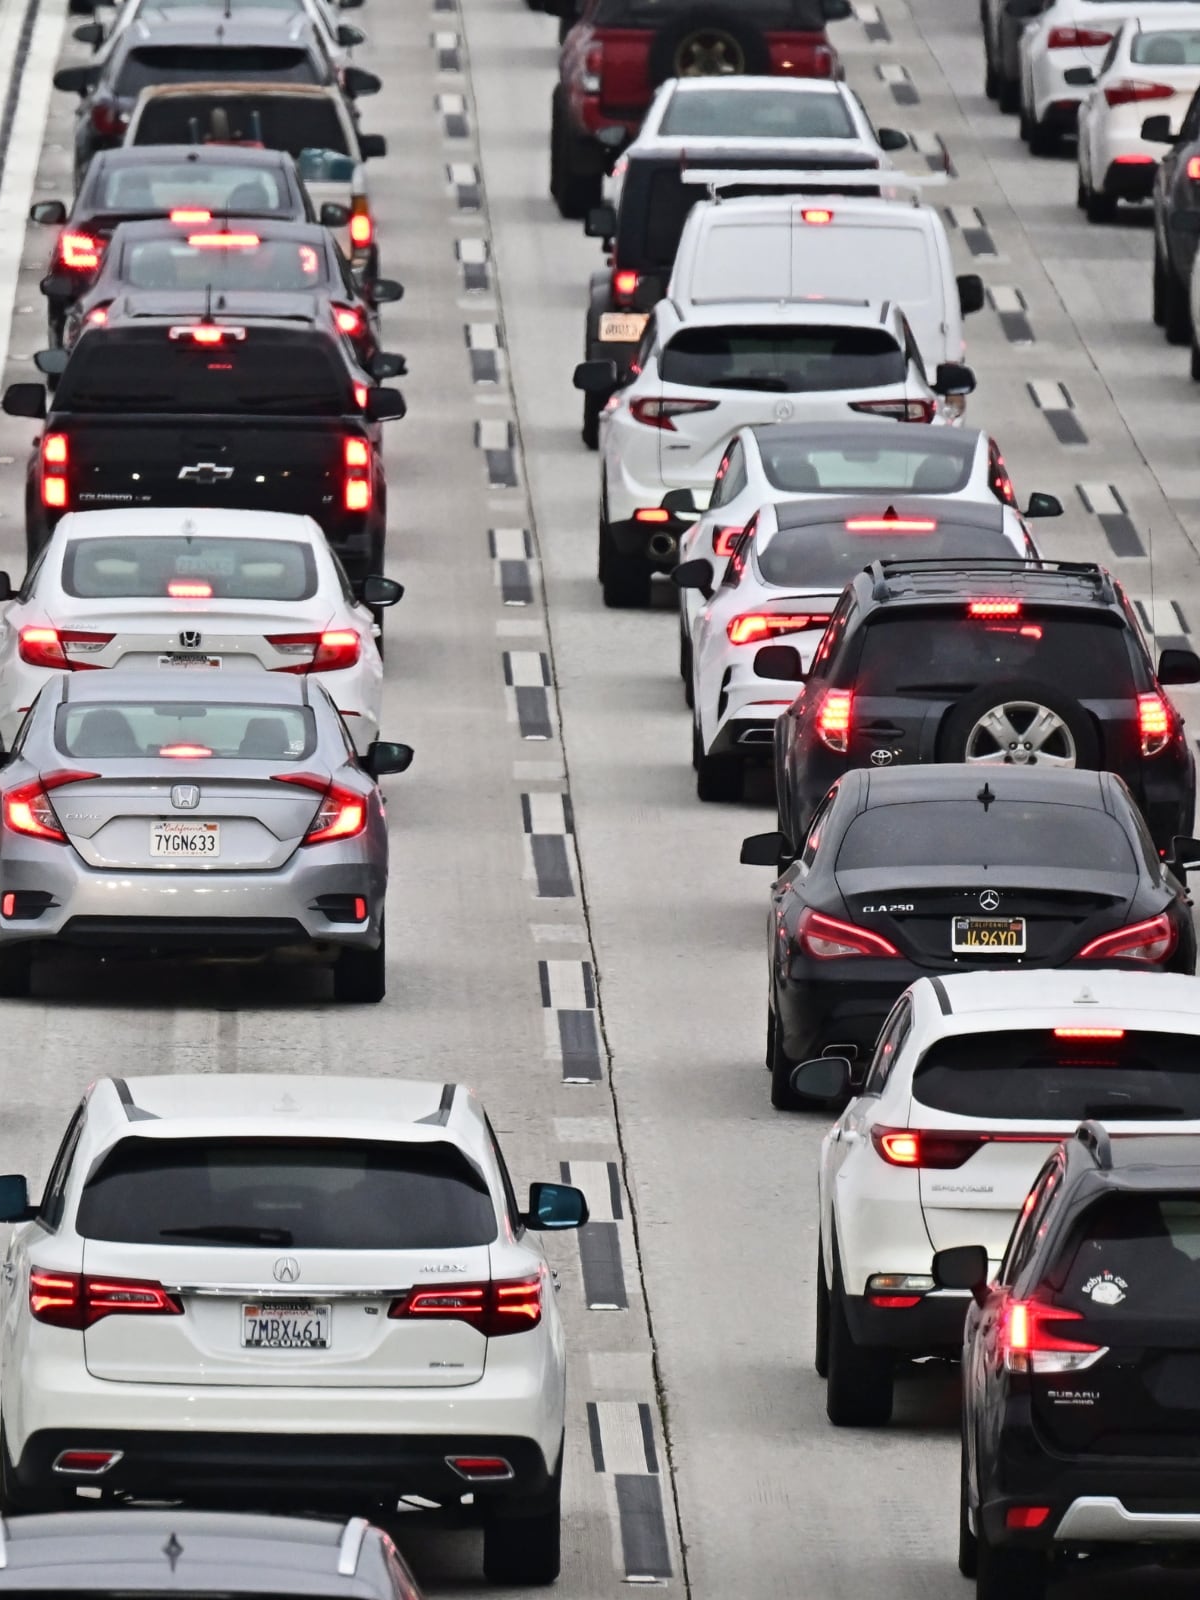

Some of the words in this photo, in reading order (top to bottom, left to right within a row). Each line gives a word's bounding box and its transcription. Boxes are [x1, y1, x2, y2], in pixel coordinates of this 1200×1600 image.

[164, 822, 207, 834] California
[155, 835, 215, 851] 7YGN633
[862, 904, 887, 913] CLA
[889, 904, 915, 912] 250
[419, 1264, 467, 1273] MDX
[248, 1319, 322, 1341] 7MBX461
[1047, 1390, 1100, 1399] SUBARU
